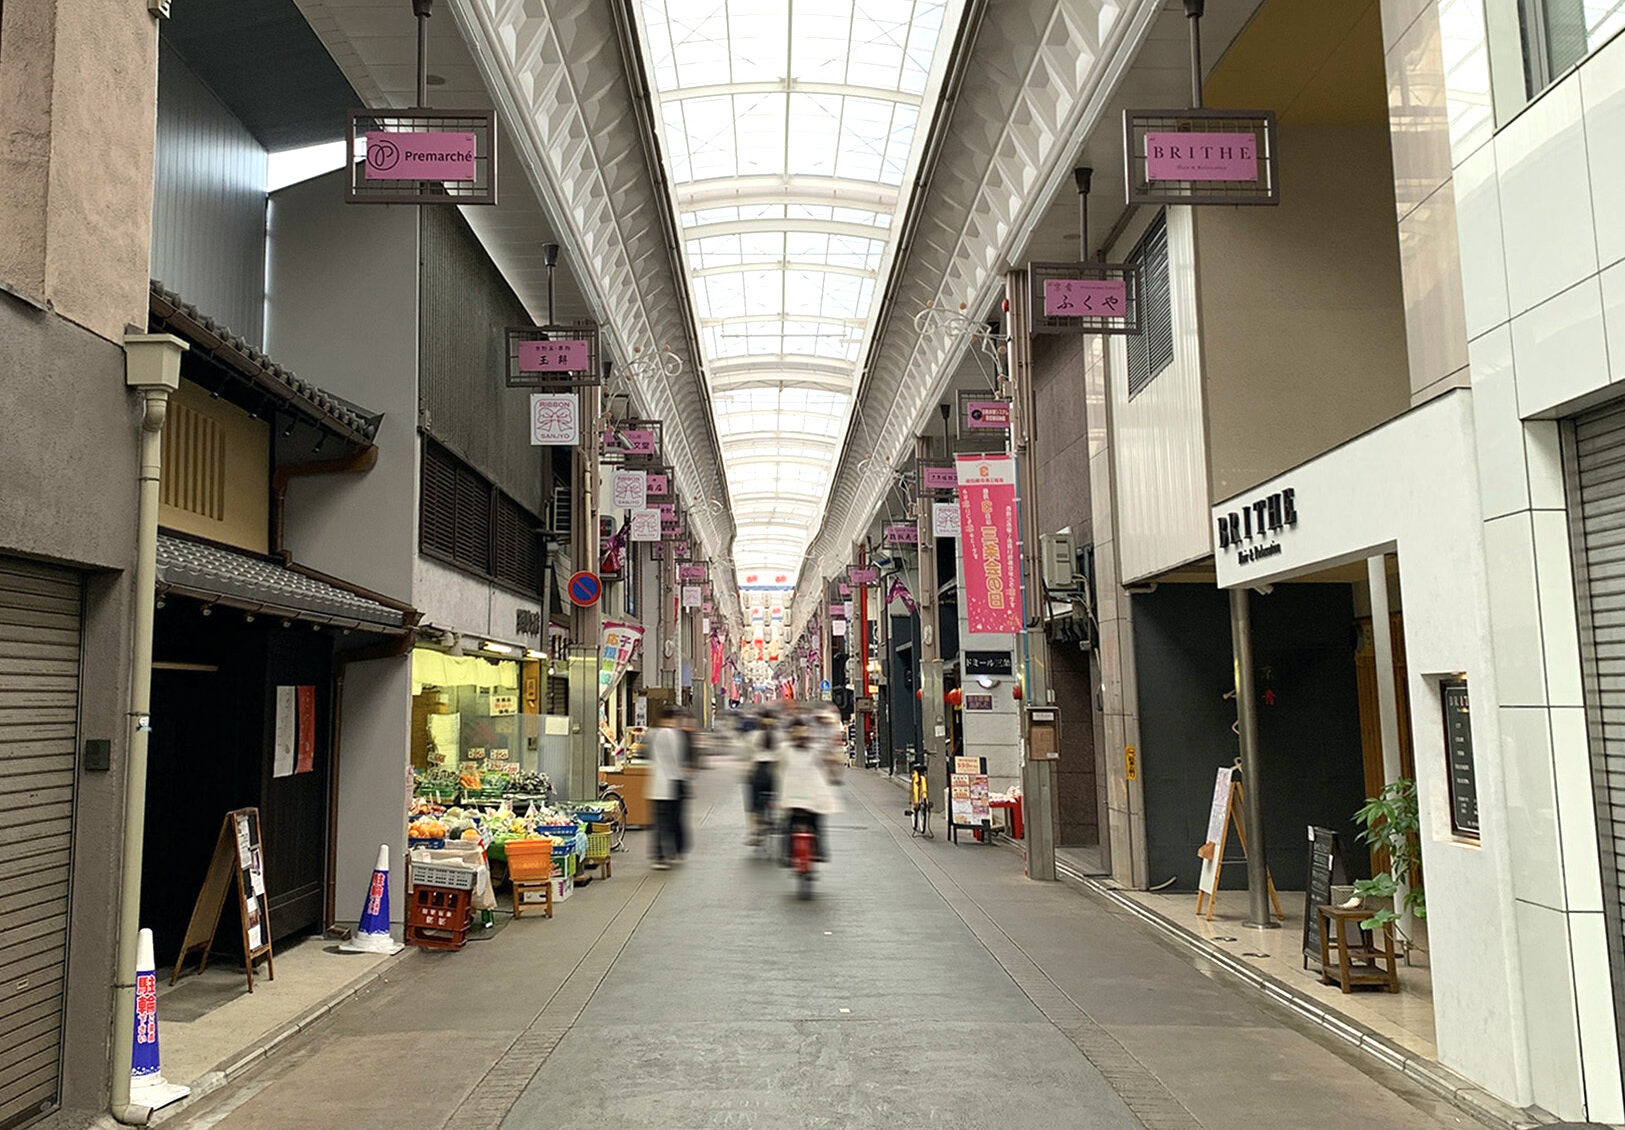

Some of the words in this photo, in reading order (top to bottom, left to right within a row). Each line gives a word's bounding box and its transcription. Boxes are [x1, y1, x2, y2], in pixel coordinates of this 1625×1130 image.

[405, 151, 473, 161] Premarché
[1153, 146, 1251, 160] BRITHE
[1057, 294, 1119, 311] ふくや
[1217, 487, 1298, 549] BRITHE
